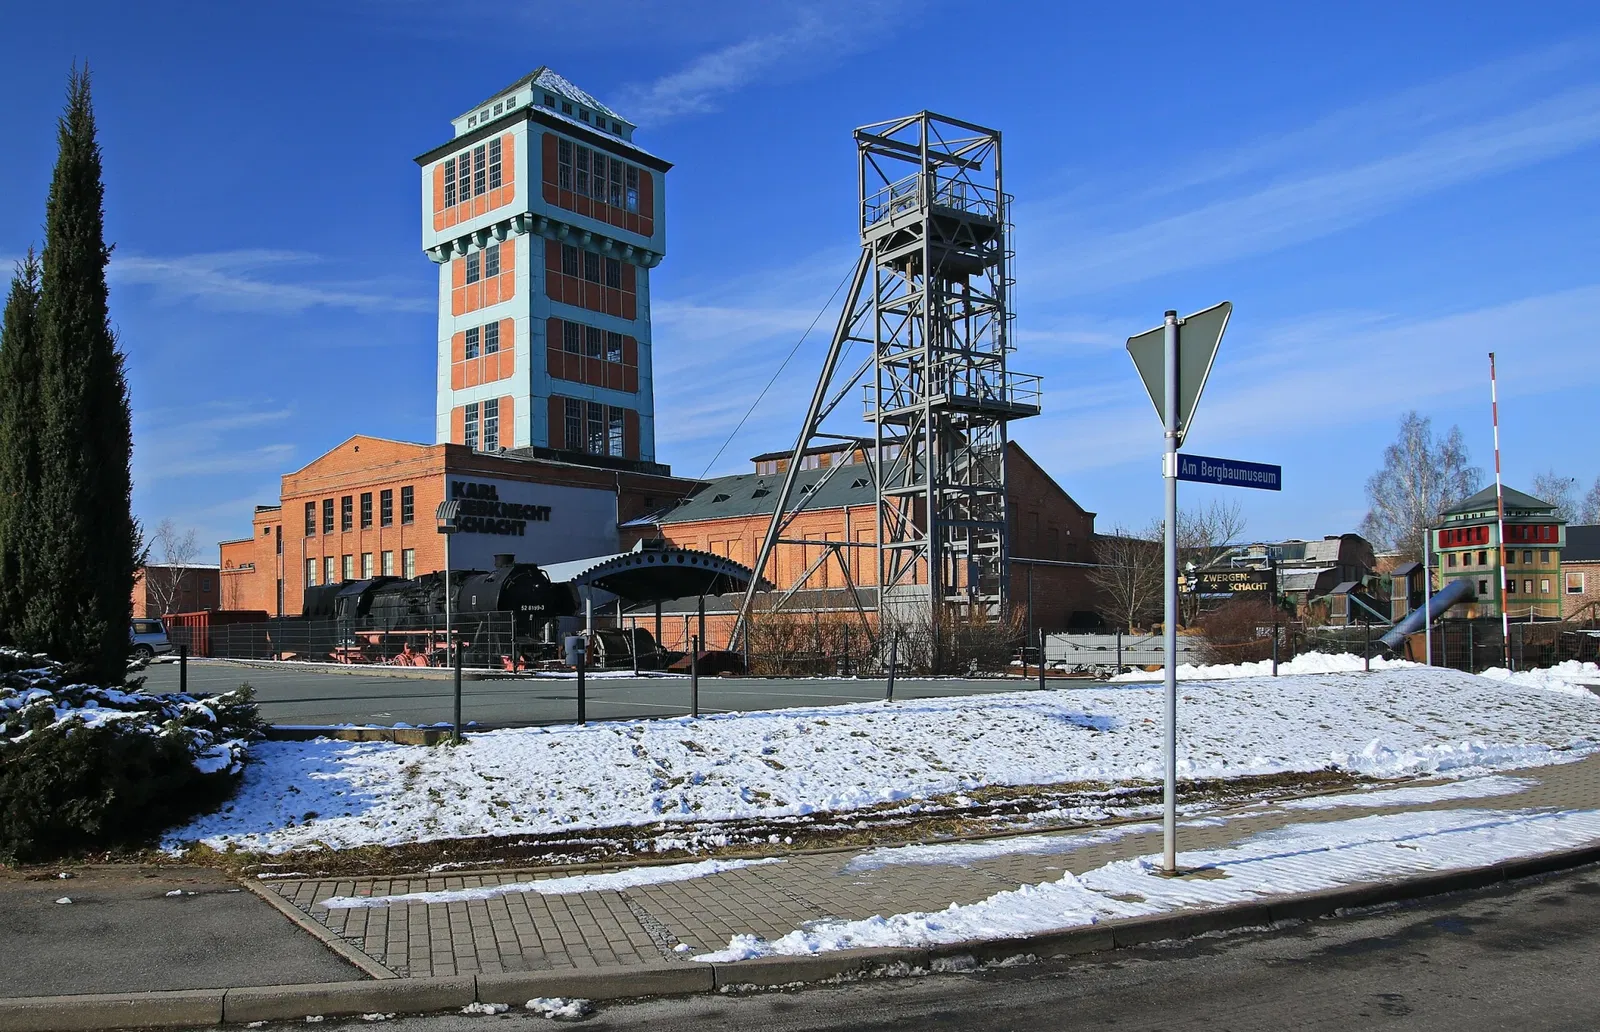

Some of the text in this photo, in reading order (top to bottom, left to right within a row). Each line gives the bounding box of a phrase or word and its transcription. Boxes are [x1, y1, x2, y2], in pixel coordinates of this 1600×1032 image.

[1181, 459, 1276, 484] Am Bergbaumuseum
[451, 481, 499, 501] KARL
[1203, 573, 1251, 582] ZWERGEN-
[1228, 582, 1269, 591] SCHACHT
